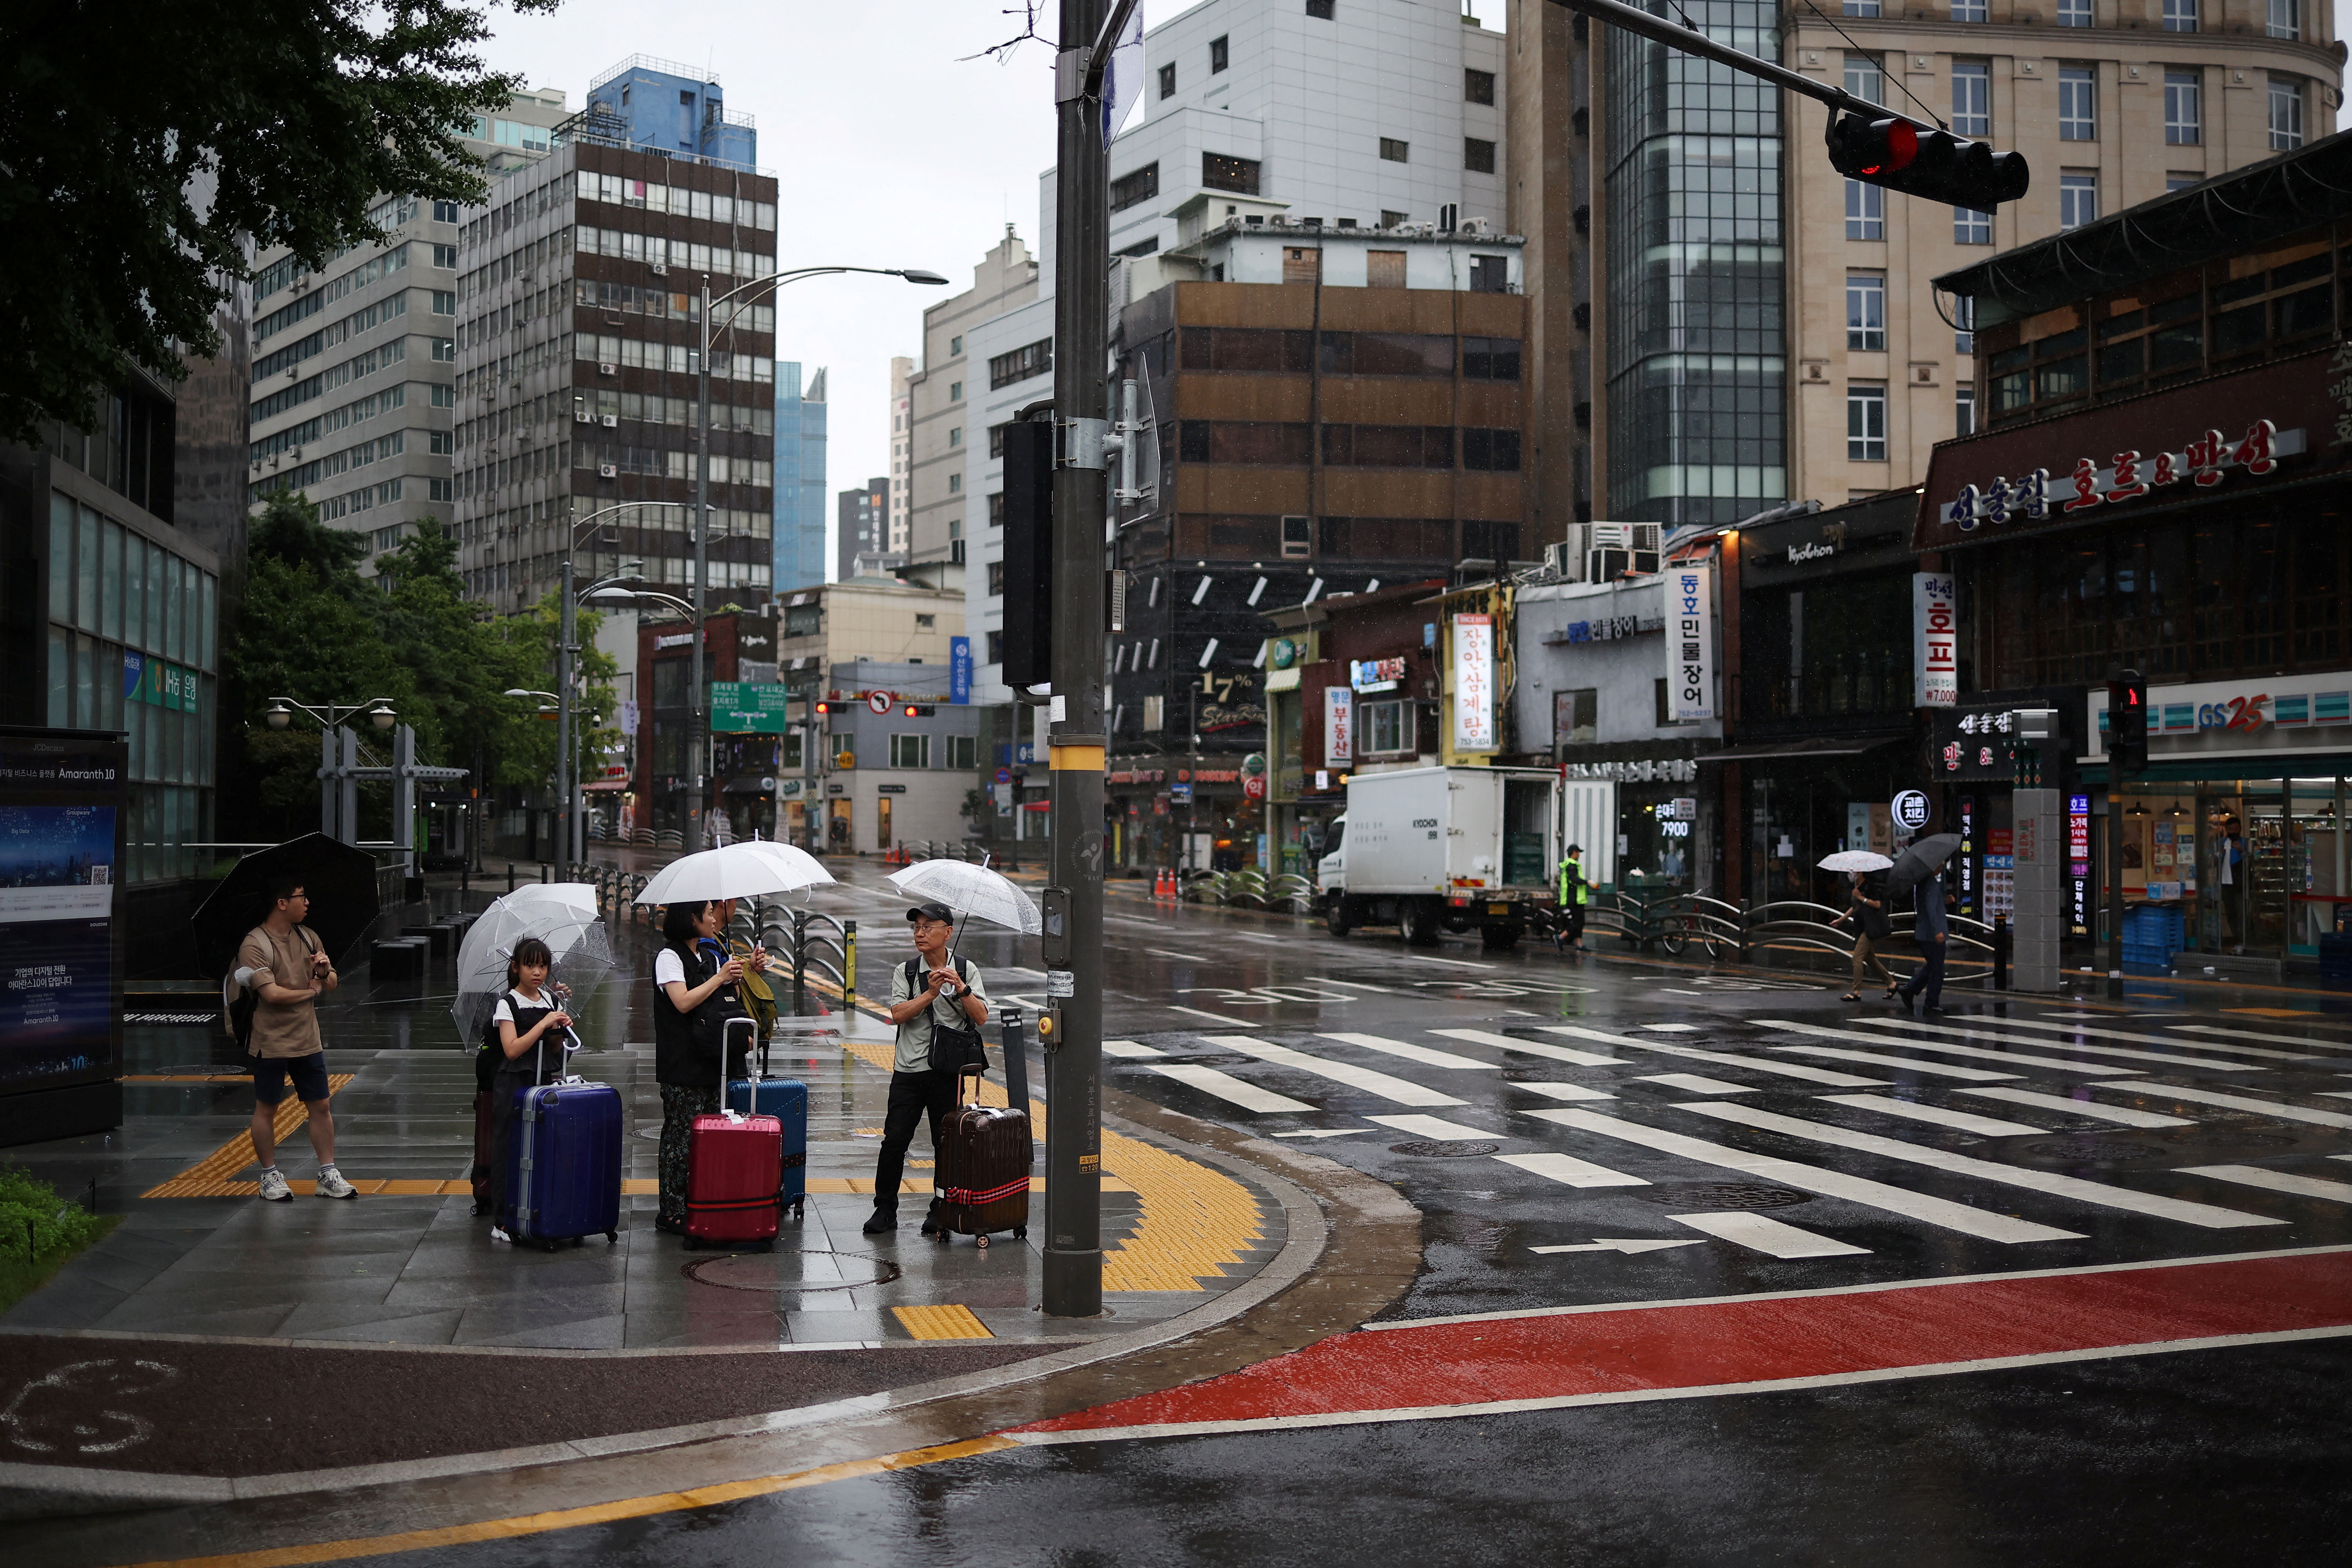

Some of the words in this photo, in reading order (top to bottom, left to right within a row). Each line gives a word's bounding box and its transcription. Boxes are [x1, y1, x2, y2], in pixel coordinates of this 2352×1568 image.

[1949, 468, 2050, 531] 선술집
[2154, 452, 2179, 486] &
[2186, 419, 2277, 486] 만선
[1681, 575, 1700, 615] 동호
[1925, 578, 1953, 599] 만선
[1926, 603, 1955, 671] 호프
[1682, 620, 1702, 706] 민물장어
[1462, 627, 1483, 737] 장안삼계탕
[1331, 691, 1348, 703] 명문
[2199, 694, 2269, 733] GS25
[1958, 711, 2013, 735] 선술집
[1334, 707, 1348, 756] 부동산
[33, 744, 64, 752] JCDecaux
[15, 769, 38, 777] 비즈니스
[39, 769, 55, 778] 플랫폼
[1249, 781, 1263, 795] 약
[1904, 797, 1924, 808] 교촌
[1905, 808, 1924, 818] 치킨
[1413, 818, 1438, 828] KYOCHON
[1661, 822, 1688, 837] 7900
[2070, 817, 2087, 828] 노가리
[1428, 831, 1437, 840] 1991
[15, 968, 33, 978] 기업의
[34, 966, 52, 976] 디지털
[53, 965, 66, 975] 전환
[8, 978, 47, 990] 아마란스10이
[48, 976, 73, 987] 답입니다
